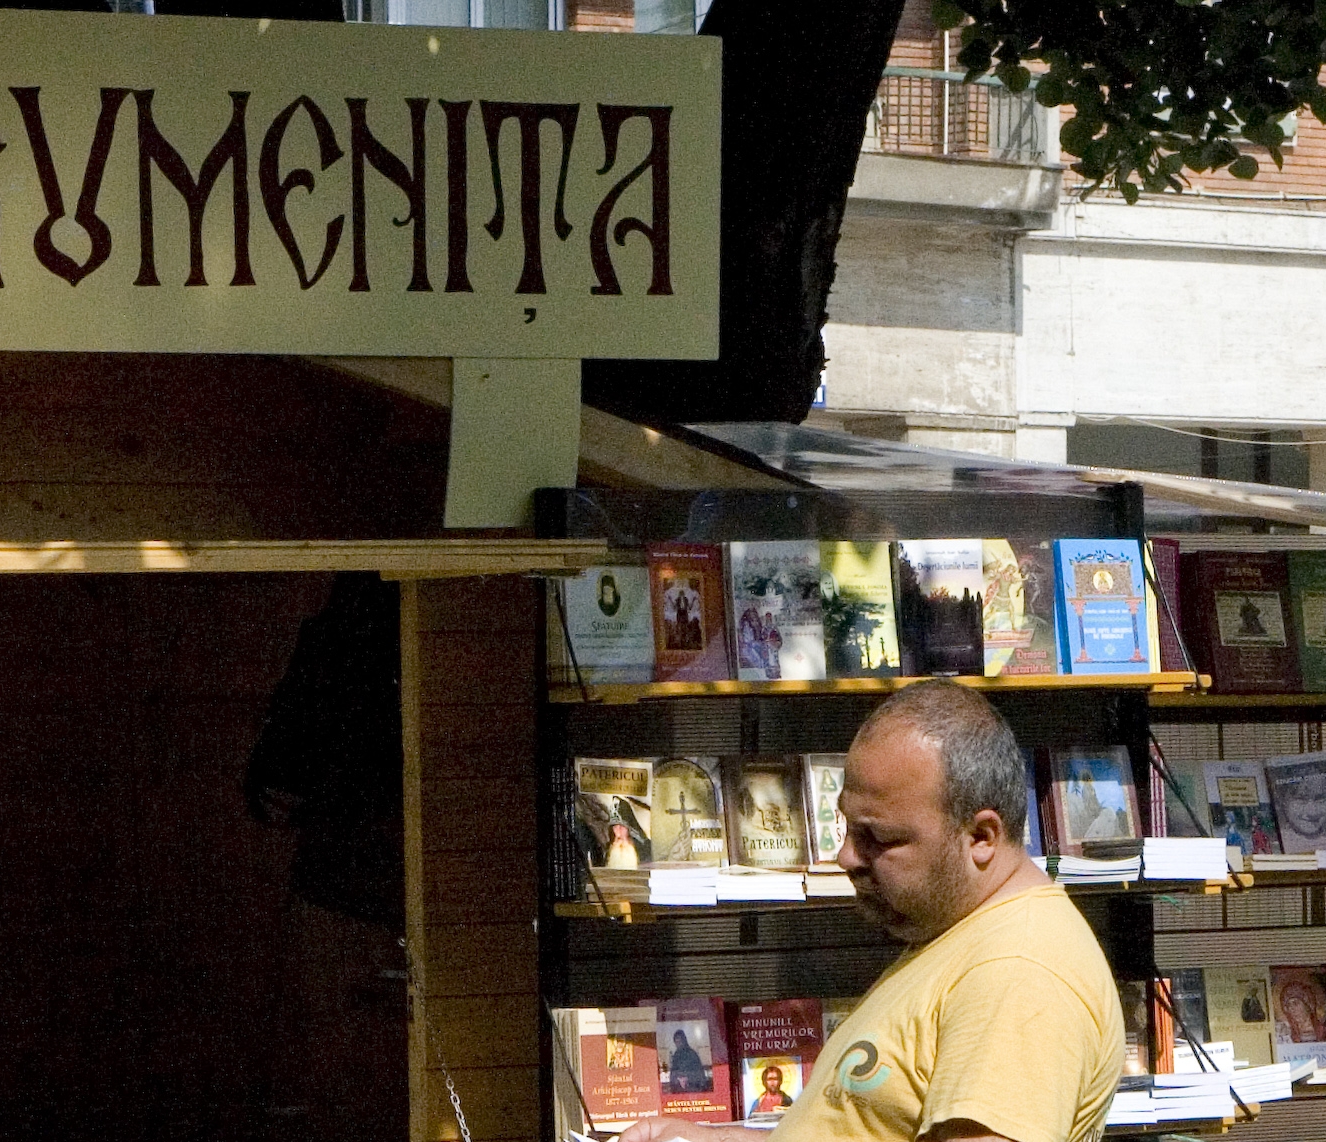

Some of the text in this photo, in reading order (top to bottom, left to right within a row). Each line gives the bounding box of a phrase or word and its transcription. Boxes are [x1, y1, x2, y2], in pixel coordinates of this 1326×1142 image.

[580, 766, 648, 782] PATERICUL
[741, 836, 799, 851] PATERICUL
[742, 1018, 793, 1028] MINUNILE
[743, 1027, 818, 1040] VREMURILOR
[743, 1041, 763, 1051] DIN
